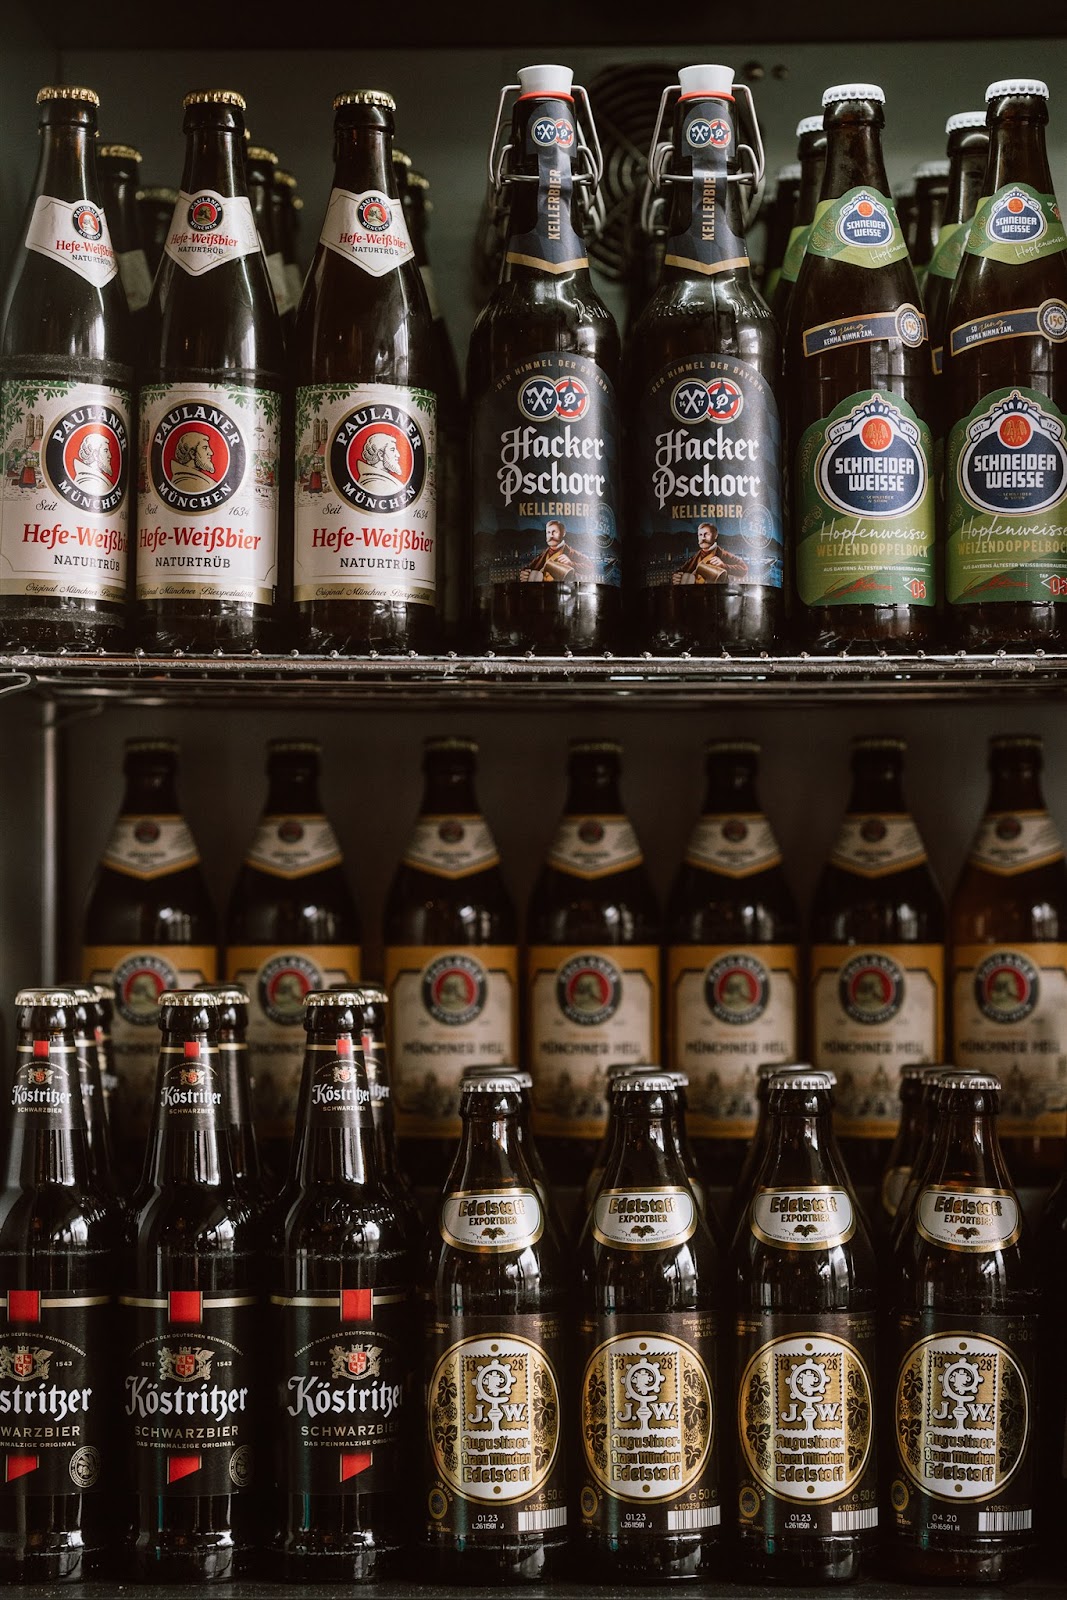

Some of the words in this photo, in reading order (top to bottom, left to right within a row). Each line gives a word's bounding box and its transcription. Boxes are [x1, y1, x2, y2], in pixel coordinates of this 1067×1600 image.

[189, 196, 222, 213] PAULANER
[548, 169, 561, 240] KELLERBIER
[702, 171, 716, 241] KELLERBIER
[188, 221, 219, 231] MÜNCHEN
[847, 220, 886, 230] SCHNEIDER
[995, 217, 1037, 226] SCHNEIDER
[1001, 224, 1031, 233] WEISSE
[170, 233, 238, 247] Hefe-Weißbier
[339, 232, 406, 249] Hefe-Weißbier
[854, 228, 881, 238] WEISSE
[178, 246, 224, 255] NATURTRÜB
[352, 246, 399, 256] NATURTRÜB
[824, 335, 841, 346] KEMMA
[842, 332, 861, 341] NIMMA
[965, 333, 982, 343] KEMMA
[982, 329, 1000, 339] NIMMA
[1000, 326, 1014, 334] ZAM.
[515, 359, 552, 375] HIMMEL
[558, 359, 576, 369] DER
[581, 366, 607, 391] BAYERN
[652, 378, 665, 393] DER
[668, 361, 704, 378] HIMMEL
[710, 361, 728, 370] DER
[733, 366, 763, 393] BAYERN
[52, 406, 127, 451] PAULANER
[154, 405, 241, 448] PAULANER
[336, 407, 421, 450] PAULANER
[833, 426, 846, 435] SEIT
[905, 425, 916, 436] 1872
[973, 423, 984, 433] SEIT
[1046, 421, 1058, 432] 1872
[500, 425, 604, 463] Hacker
[655, 426, 759, 468] Hacker
[835, 457, 915, 475] SCHNEIDER
[974, 453, 1056, 472] SCHNEIDER
[497, 461, 605, 507] Pschorr
[652, 463, 760, 510] Pschorr
[849, 474, 904, 491] WEISSE
[986, 471, 1044, 489] WEISSE
[58, 479, 124, 510] MÜNCHEN
[158, 481, 233, 509] MÜNCHEN
[342, 482, 415, 509] MÜNCHEN
[36, 499, 58, 512] Seit
[228, 505, 250, 518] 1634
[322, 503, 342, 515] Seit
[412, 509, 428, 520] 1634
[519, 501, 591, 516] KELLERBIER
[672, 504, 742, 519] KELLERBIER
[821, 518, 928, 545] Hopfenweisse
[961, 515, 1067, 545] Hopfenweisse
[139, 526, 262, 552] Hefe-Weißbier
[312, 527, 433, 554] Hefe-Weißbier
[817, 543, 928, 558] WEIZENDOPPELBOCK
[53, 554, 120, 572] NATURTRÜB
[155, 556, 231, 569] NATURTRÜB
[340, 558, 415, 571] NATURTRÜB
[25, 583, 57, 594] Original
[159, 587, 196, 597] Münchner
[316, 587, 343, 597] Original
[912, 580, 926, 599] 05
[11, 1085, 72, 1106] Köstritzer
[161, 1086, 221, 1107] Köstritzer
[312, 1083, 370, 1105] Köstritzer
[458, 1198, 525, 1217] Edelstoff
[608, 1197, 676, 1215] Edelstoff
[770, 1196, 837, 1213] Edelstoff
[934, 1196, 1003, 1216] Edelstoff
[468, 1216, 518, 1226] EXPORTBIER
[618, 1214, 668, 1224] EXPORTBIER
[780, 1213, 830, 1223] EXPORTBIER
[944, 1215, 994, 1226] EXPORTBIER
[45, 1335, 86, 1357] REINHEITSGEBOT
[466, 1360, 476, 1372] 13
[512, 1359, 523, 1371] 28
[614, 1358, 625, 1370] 13
[661, 1358, 673, 1370] 28
[779, 1359, 790, 1370] 13
[826, 1359, 838, 1371] 28
[933, 1356, 943, 1368] 13
[980, 1359, 992, 1371] 28
[0, 1383, 93, 1421] stritzer
[125, 1376, 248, 1422] Köstritzer
[468, 1404, 489, 1422] J.
[501, 1404, 528, 1422] W.
[616, 1403, 637, 1421] J.
[650, 1402, 677, 1421] W.
[781, 1403, 802, 1422] J.
[815, 1403, 841, 1421] W.
[932, 1402, 952, 1420] J.
[967, 1403, 992, 1422] W.
[135, 1425, 239, 1438] SCHWARZBIER
[462, 1435, 531, 1452] Augustiner-
[611, 1433, 680, 1450] Augustiner-
[775, 1434, 844, 1450] Augustiner-
[925, 1432, 995, 1449] Augustiner-
[490, 1451, 531, 1465] München
[639, 1450, 681, 1464] München
[803, 1450, 844, 1464] München
[952, 1450, 995, 1465] München
[463, 1467, 531, 1484] Edelstoff
[612, 1465, 680, 1482] Edelstoff
[776, 1466, 844, 1482] Edelstoff
[925, 1462, 994, 1482] Edelstoff
[548, 1489, 558, 1501] 50
[698, 1488, 710, 1500] 50
[860, 1490, 870, 1500] 50
[478, 1514, 498, 1522] 01.23
[626, 1513, 646, 1522] 01.23
[790, 1514, 811, 1522] 01.23
